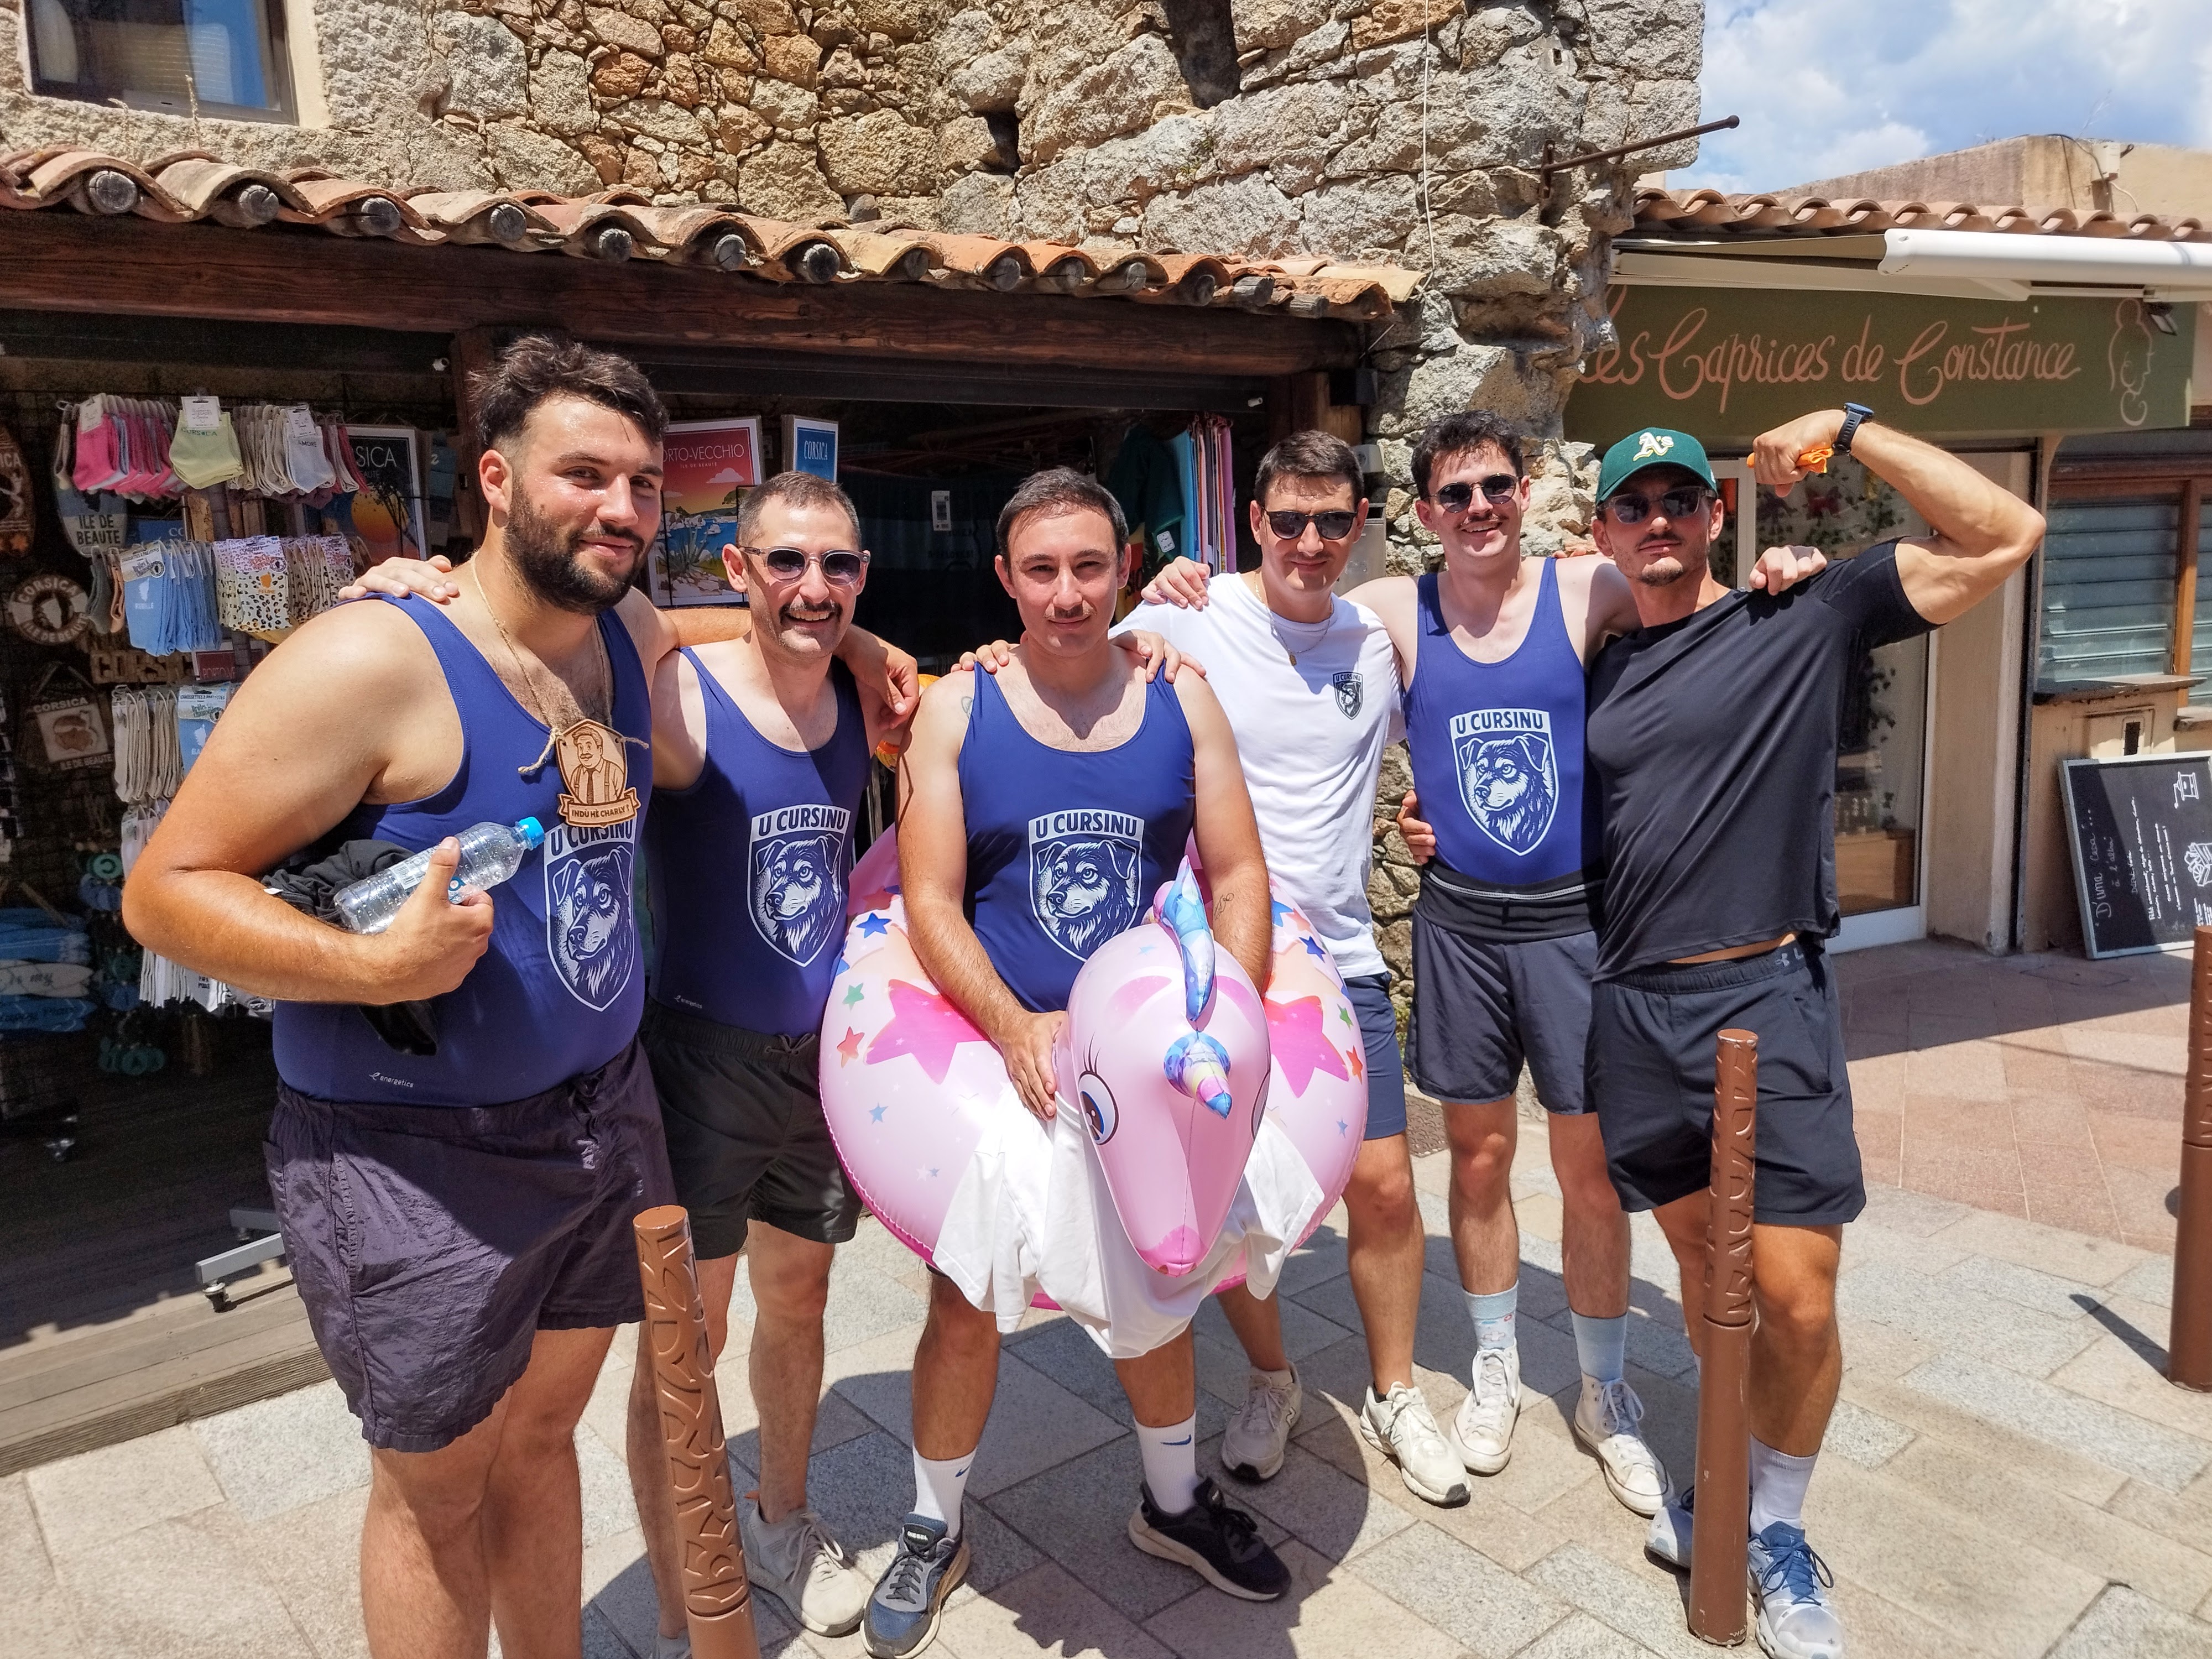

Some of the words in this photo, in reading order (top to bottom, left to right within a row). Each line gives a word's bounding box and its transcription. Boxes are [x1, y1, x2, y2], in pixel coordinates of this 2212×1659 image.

[1647, 308, 1835, 414] Caprices
[1842, 315, 1882, 383] de
[1893, 316, 2081, 405] Constance
[804, 440, 828, 461] CORSICA
[100, 514, 114, 528] DE
[18, 577, 78, 603] CORSICA
[41, 633, 56, 642] DE
[33, 697, 89, 713] CORSICA
[1455, 717, 1466, 734] U
[1470, 711, 1543, 731] CURSINU
[571, 807, 589, 818] INDÙ
[600, 806, 625, 818] CHARLY
[758, 815, 773, 836] U
[776, 807, 847, 831] CURSINU
[1035, 818, 1048, 838] U
[1053, 812, 1137, 837] CURSINU
[550, 830, 563, 856] U
[567, 821, 633, 848] CURSINU
[379, 1075, 414, 1088] energetics
